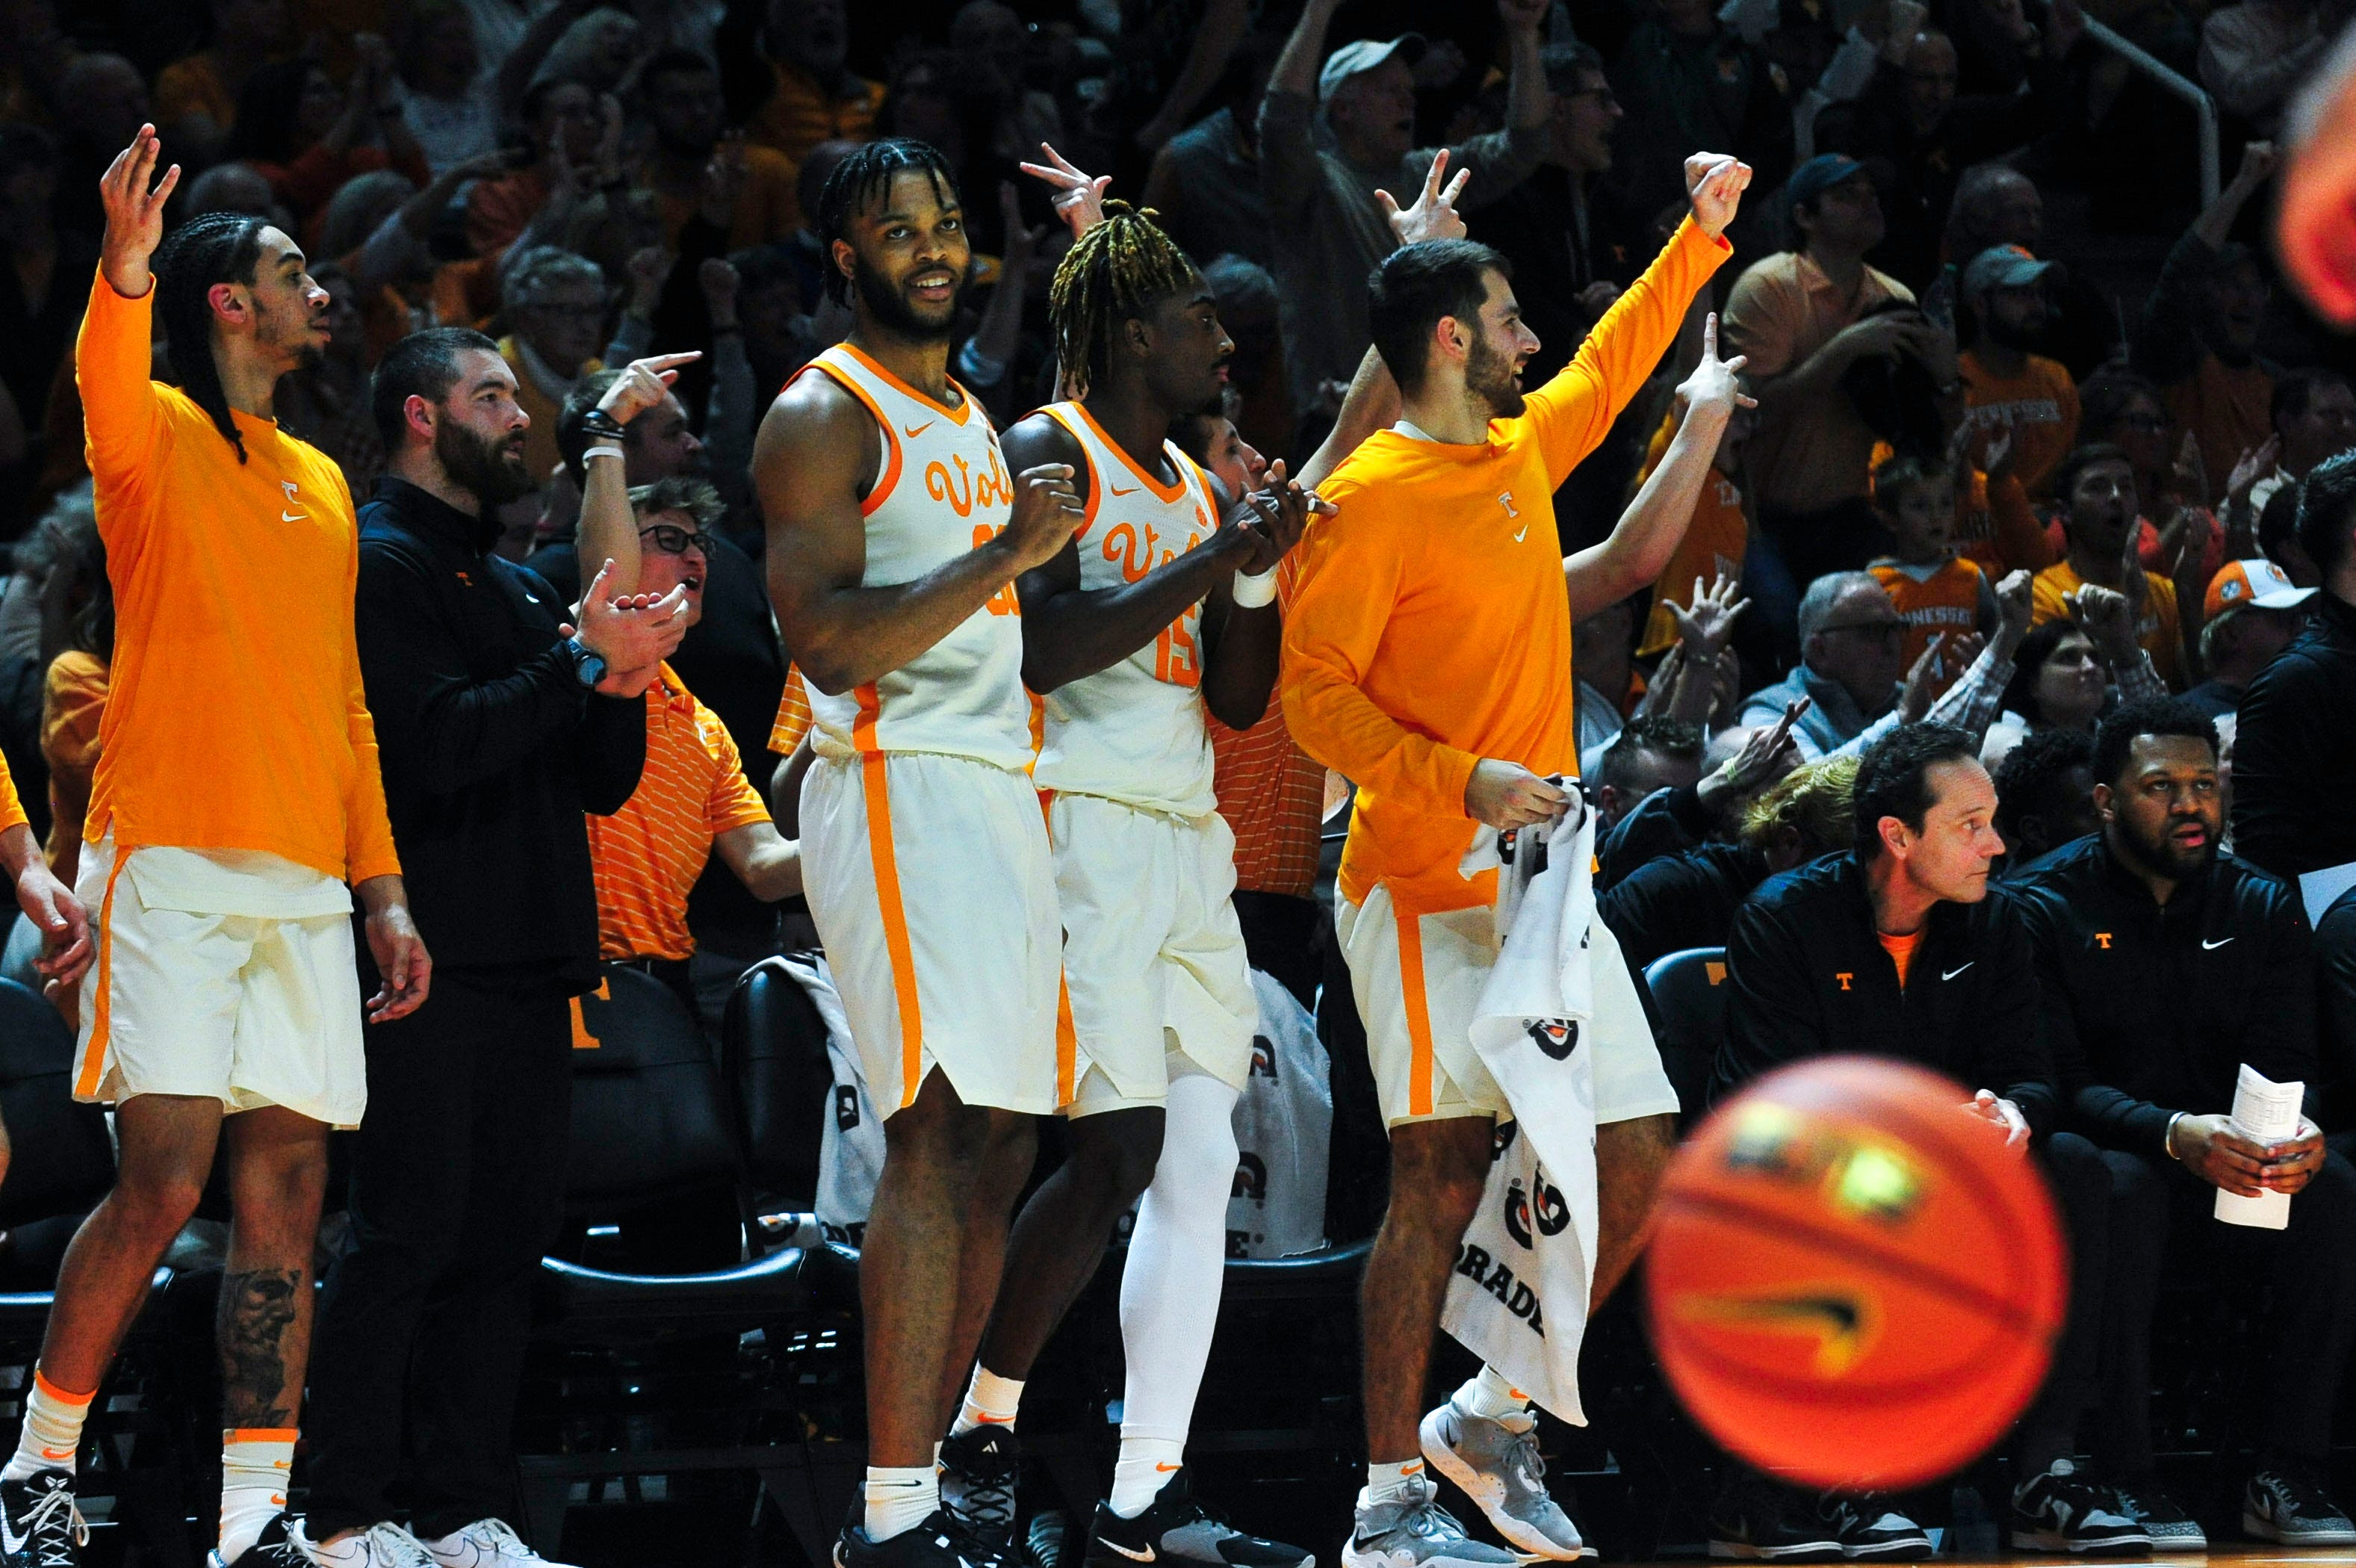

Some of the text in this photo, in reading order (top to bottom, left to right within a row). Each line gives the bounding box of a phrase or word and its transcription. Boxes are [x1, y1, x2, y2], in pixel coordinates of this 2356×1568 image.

[1498, 491, 1519, 518] T
[2095, 933, 2112, 949] T
[1836, 973, 1853, 991] T
[1457, 1242, 1546, 1339] RAD
